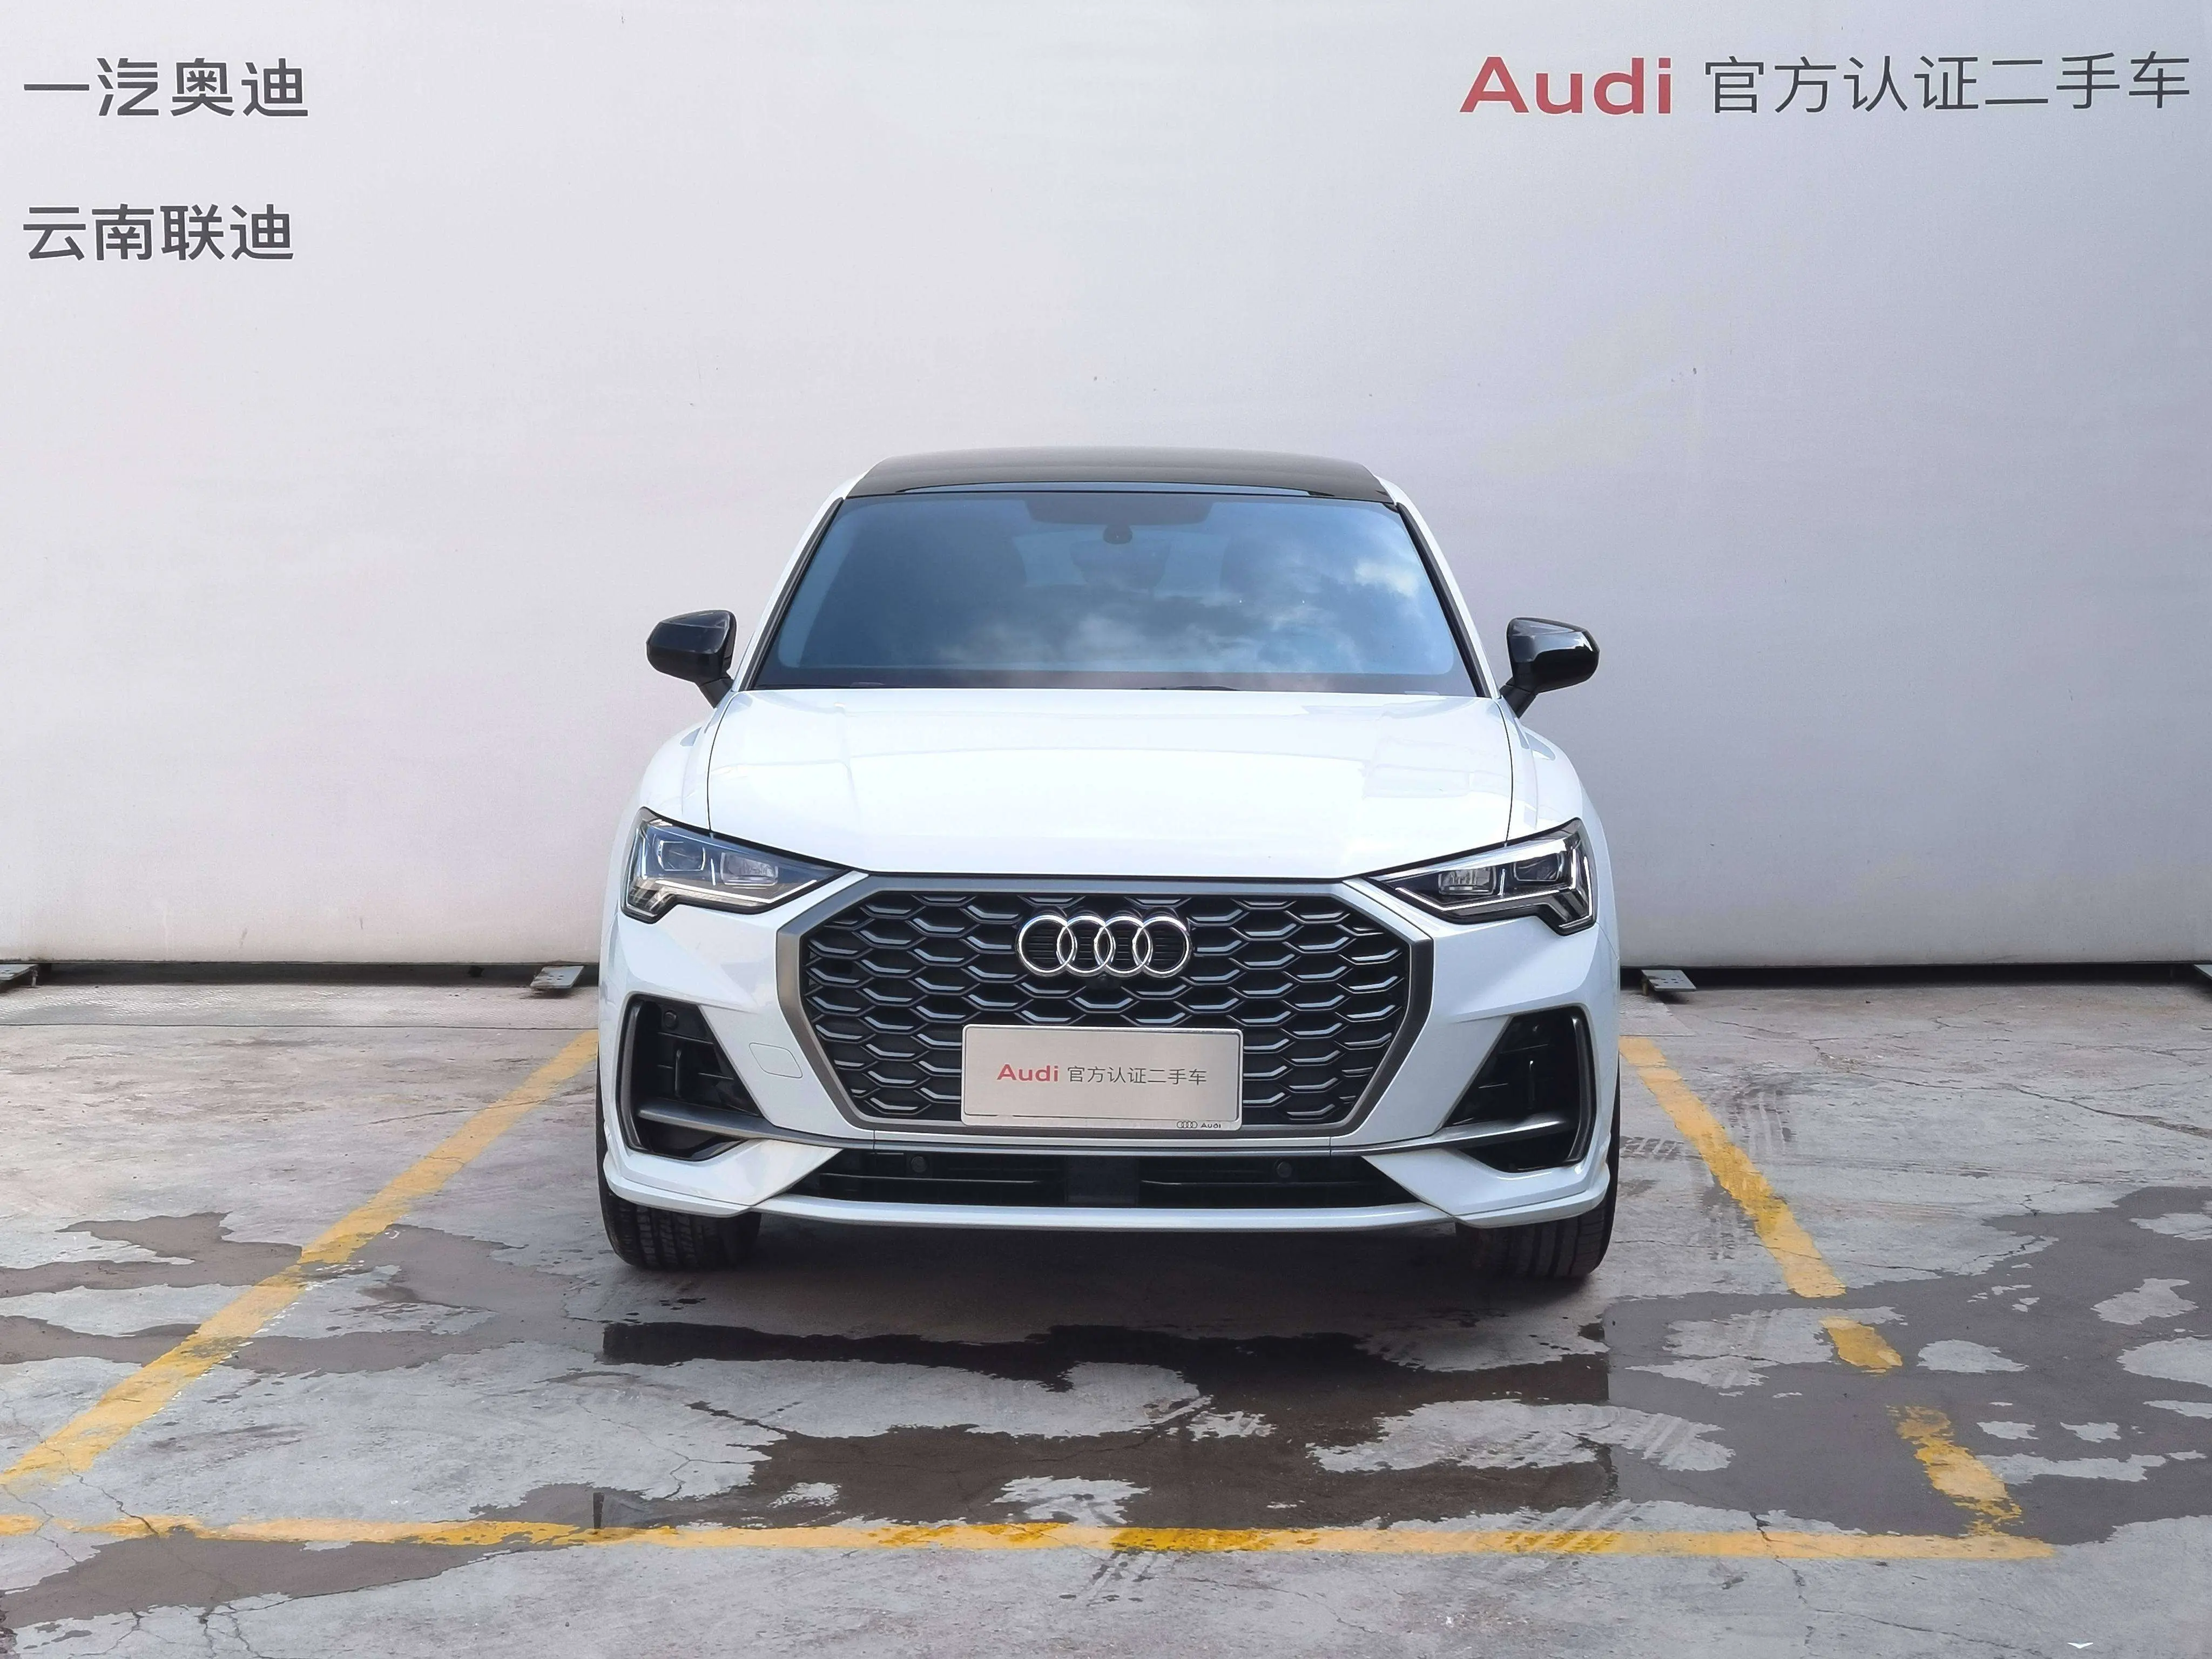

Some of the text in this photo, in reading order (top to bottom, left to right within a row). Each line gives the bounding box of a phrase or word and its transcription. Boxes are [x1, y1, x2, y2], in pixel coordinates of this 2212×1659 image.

[23, 57, 308, 117] 一汽奥迪
[1459, 50, 2191, 115] Audi 官方认证二手车
[23, 203, 294, 261] 云南联迪
[996, 1063, 1208, 1086] Audi 官方认证二手车
